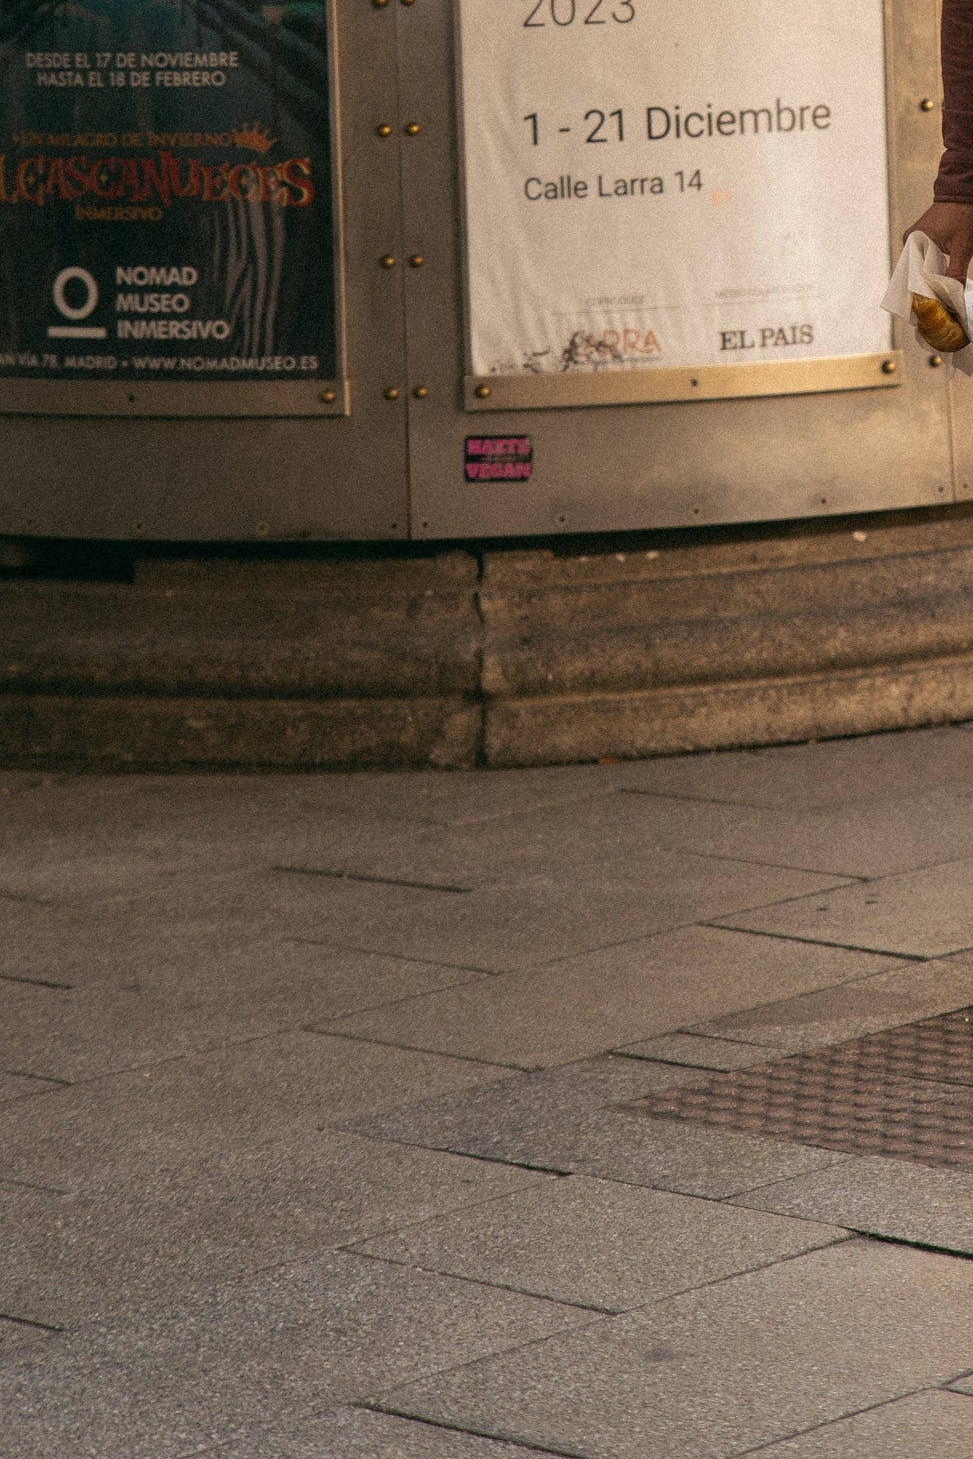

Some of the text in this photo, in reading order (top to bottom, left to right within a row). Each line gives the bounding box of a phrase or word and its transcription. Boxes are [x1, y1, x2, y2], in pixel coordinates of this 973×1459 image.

[26, 51, 239, 69] DESDE EL 17 DE NOVIEMBRE
[37, 71, 226, 87] HASTA EL 18 DE FEBRERO
[523, 111, 540, 146] 1
[584, 108, 626, 143] 21
[647, 97, 832, 140] Diciembre
[524, 169, 704, 201] Calle Larra 14
[115, 266, 198, 286] NOMAD
[115, 293, 190, 313] MUSEO
[116, 320, 230, 340] INMERSIVO
[718, 329, 755, 351] EL
